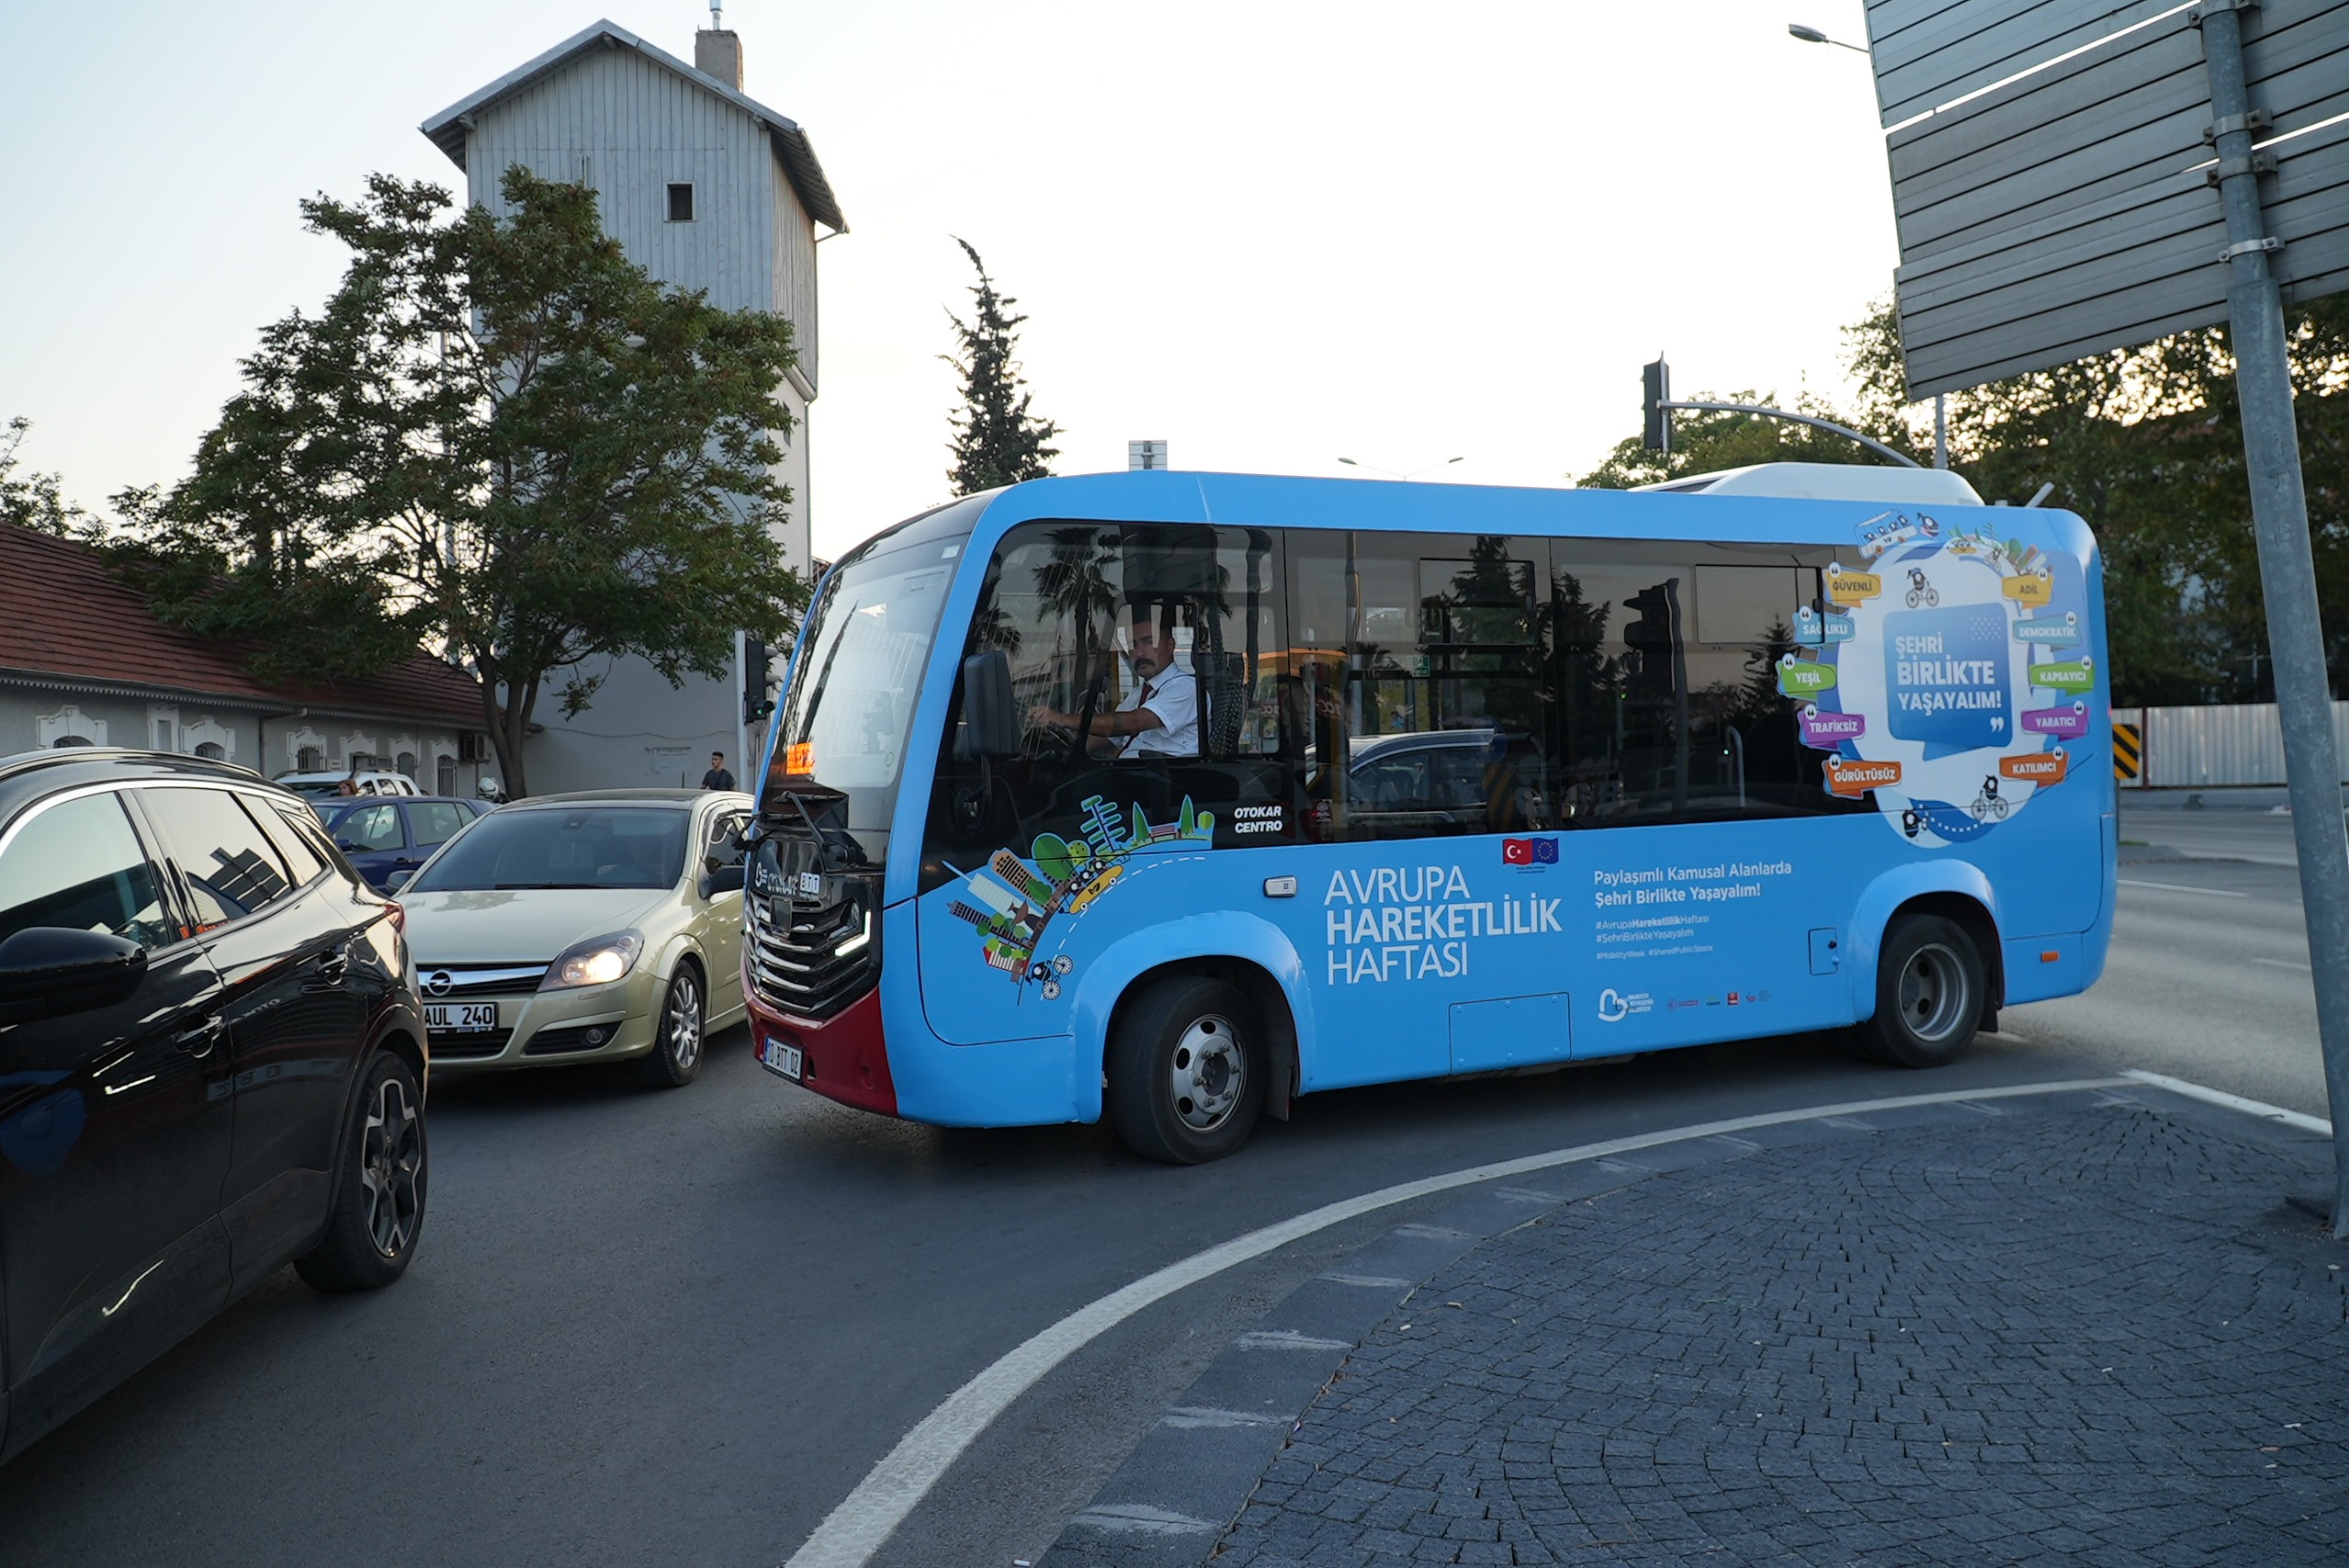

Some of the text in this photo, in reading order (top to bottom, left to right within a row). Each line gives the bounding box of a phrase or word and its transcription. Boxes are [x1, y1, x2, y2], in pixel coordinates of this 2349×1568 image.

[1832, 578, 1873, 592] GÜVENLİ
[2020, 584, 2039, 595] ADİL
[2019, 625, 2076, 638] DEMOKRATİK
[1895, 631, 1943, 660] ŞEHRİ
[1897, 654, 1996, 685] BİRLİKTE
[2040, 671, 2087, 683] KAPSAYICI
[1795, 670, 1821, 686] YEŞİL
[1898, 690, 2002, 717] YAŞAYALIM!
[1809, 719, 1859, 733] TRAFİKSİZ
[2034, 716, 2076, 728] YARATICI
[1833, 767, 1897, 783] GÜRÜLTÜSÜZ
[2011, 762, 2057, 774] KATILIMCI
[1233, 806, 1282, 819] OTOKAR
[1234, 819, 1283, 834] CENTRO
[1594, 861, 1792, 887] Paylaşımlı Kamusal Alanlarda
[1324, 865, 1471, 906] AVRUPA
[1595, 883, 1762, 909] Şehri Birlikte Yaşayalım!
[1327, 893, 1563, 945] HAREKETLİLİK
[1328, 941, 1468, 985] HAFTASI
[425, 1006, 494, 1026] AUL 240
